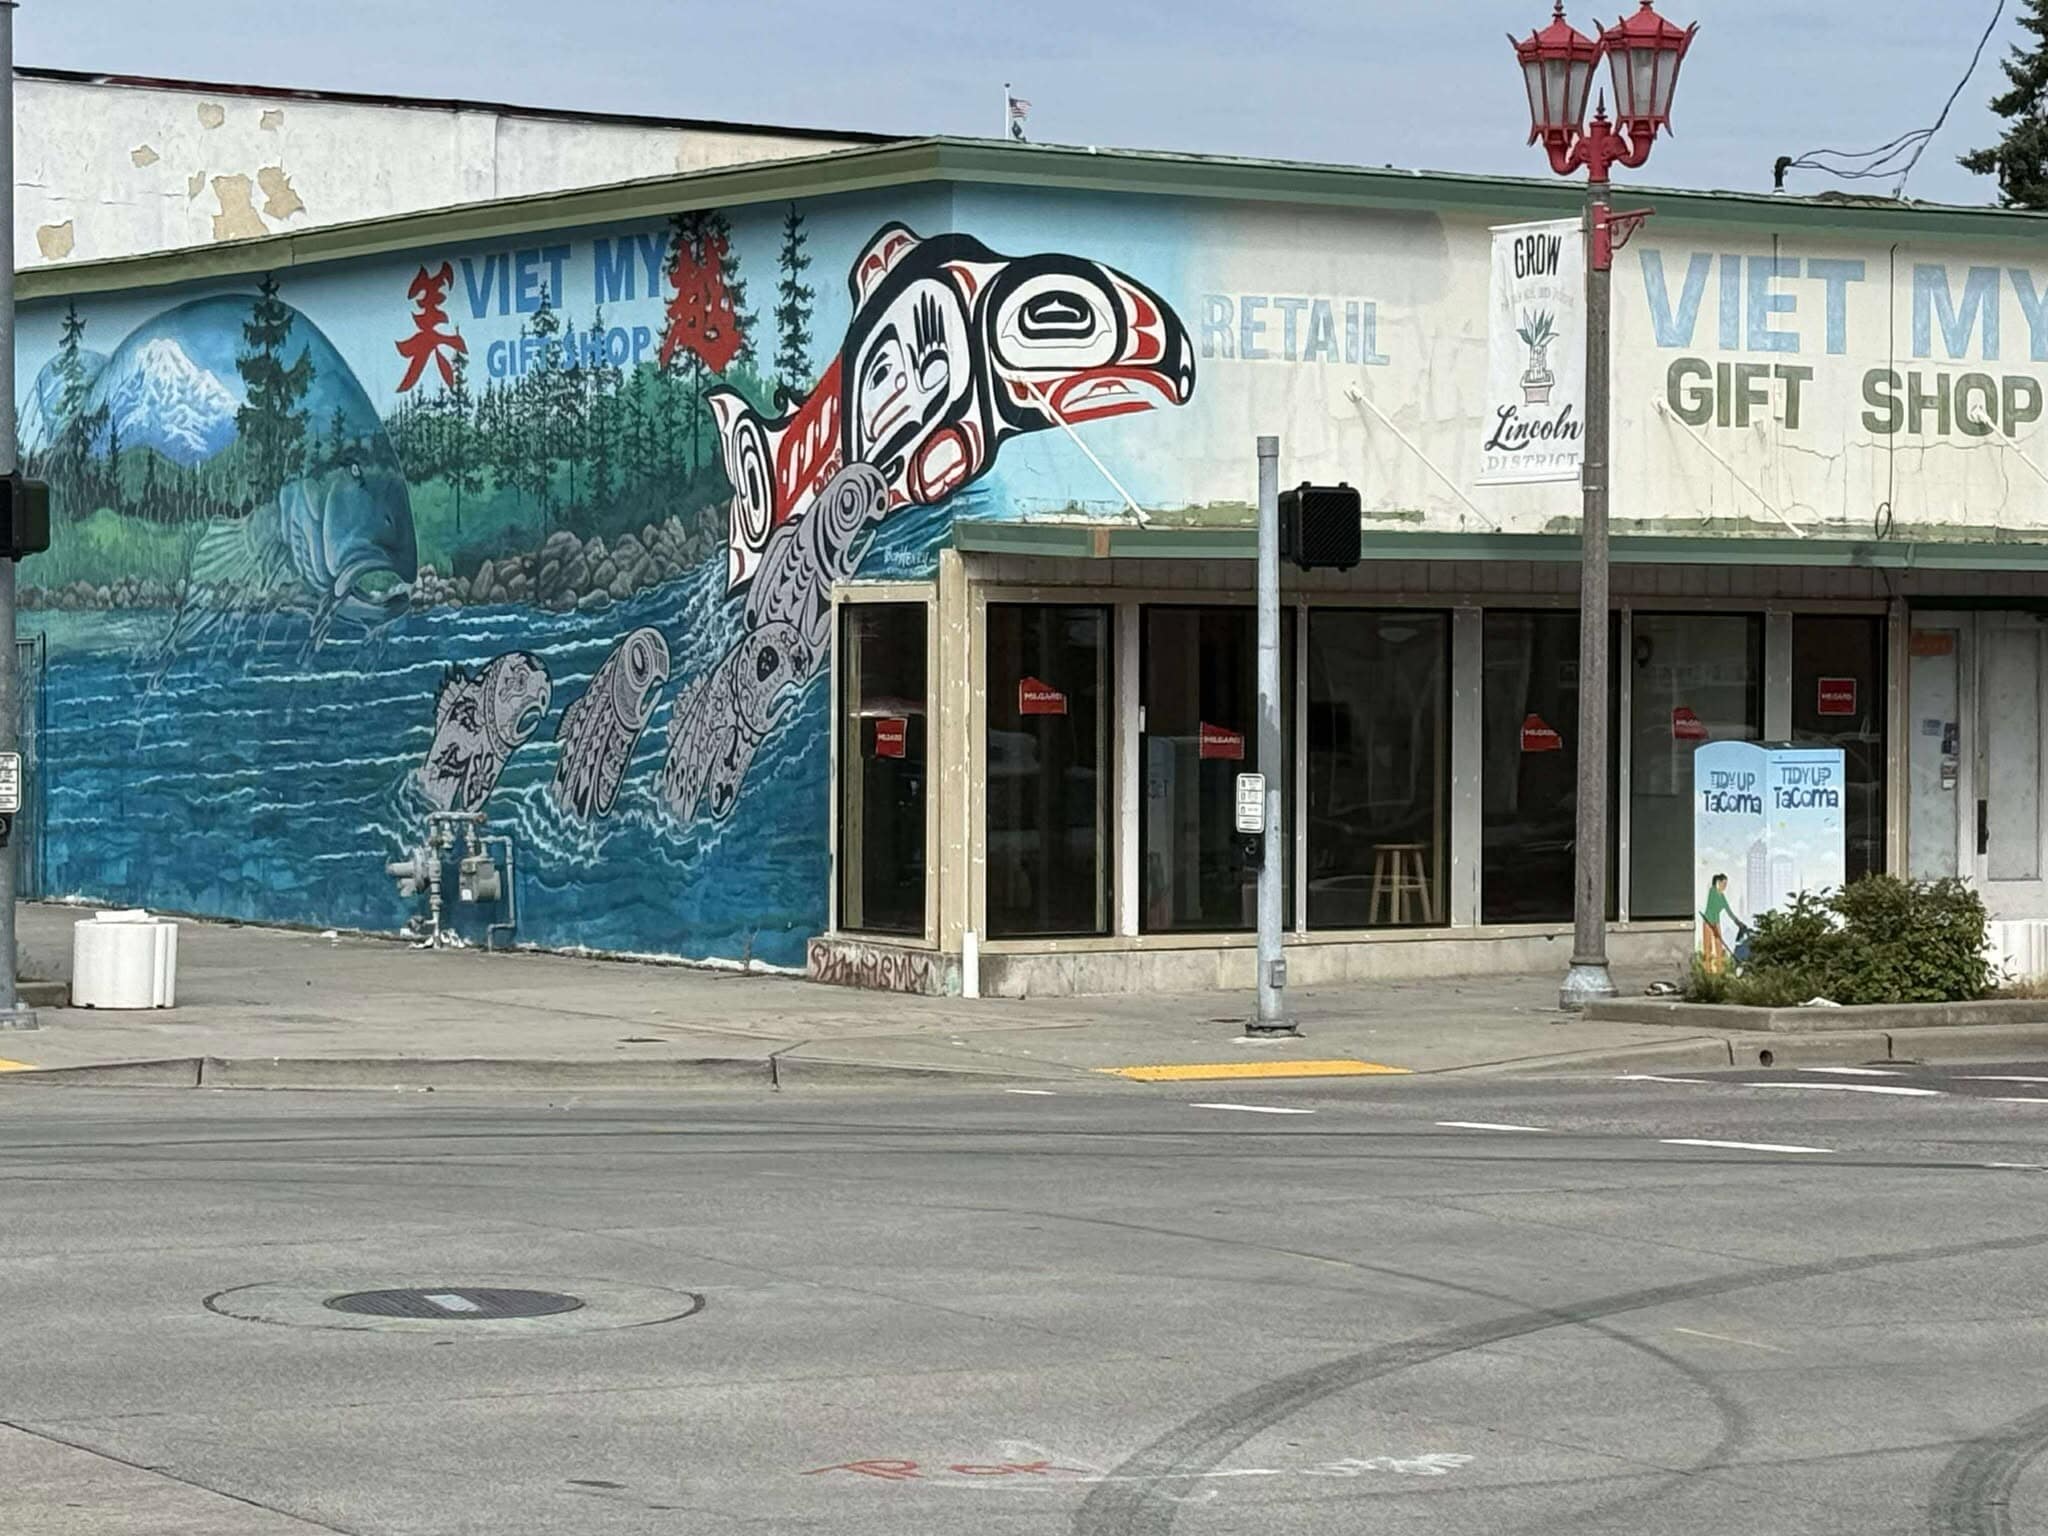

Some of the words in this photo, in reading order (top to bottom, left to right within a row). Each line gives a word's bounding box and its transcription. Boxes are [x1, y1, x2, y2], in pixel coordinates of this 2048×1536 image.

[461, 244, 571, 319] VIET
[593, 230, 672, 305] MY
[1514, 233, 1562, 279] GROW
[395, 261, 468, 393] 美
[1201, 294, 1391, 366] RETAIL
[1639, 248, 1866, 355] VIET
[1912, 263, 2048, 362] MY
[487, 335, 550, 378] GIFT
[561, 326, 651, 371] SHOP
[1484, 403, 1584, 451] Lincoln
[1667, 357, 1814, 430] GIFT
[1862, 368, 2044, 438] SHOP
[1710, 771, 1736, 789] TIDY
[1737, 772, 1756, 791] UP
[1781, 766, 1811, 785] TIDY
[1812, 766, 1832, 787] UP
